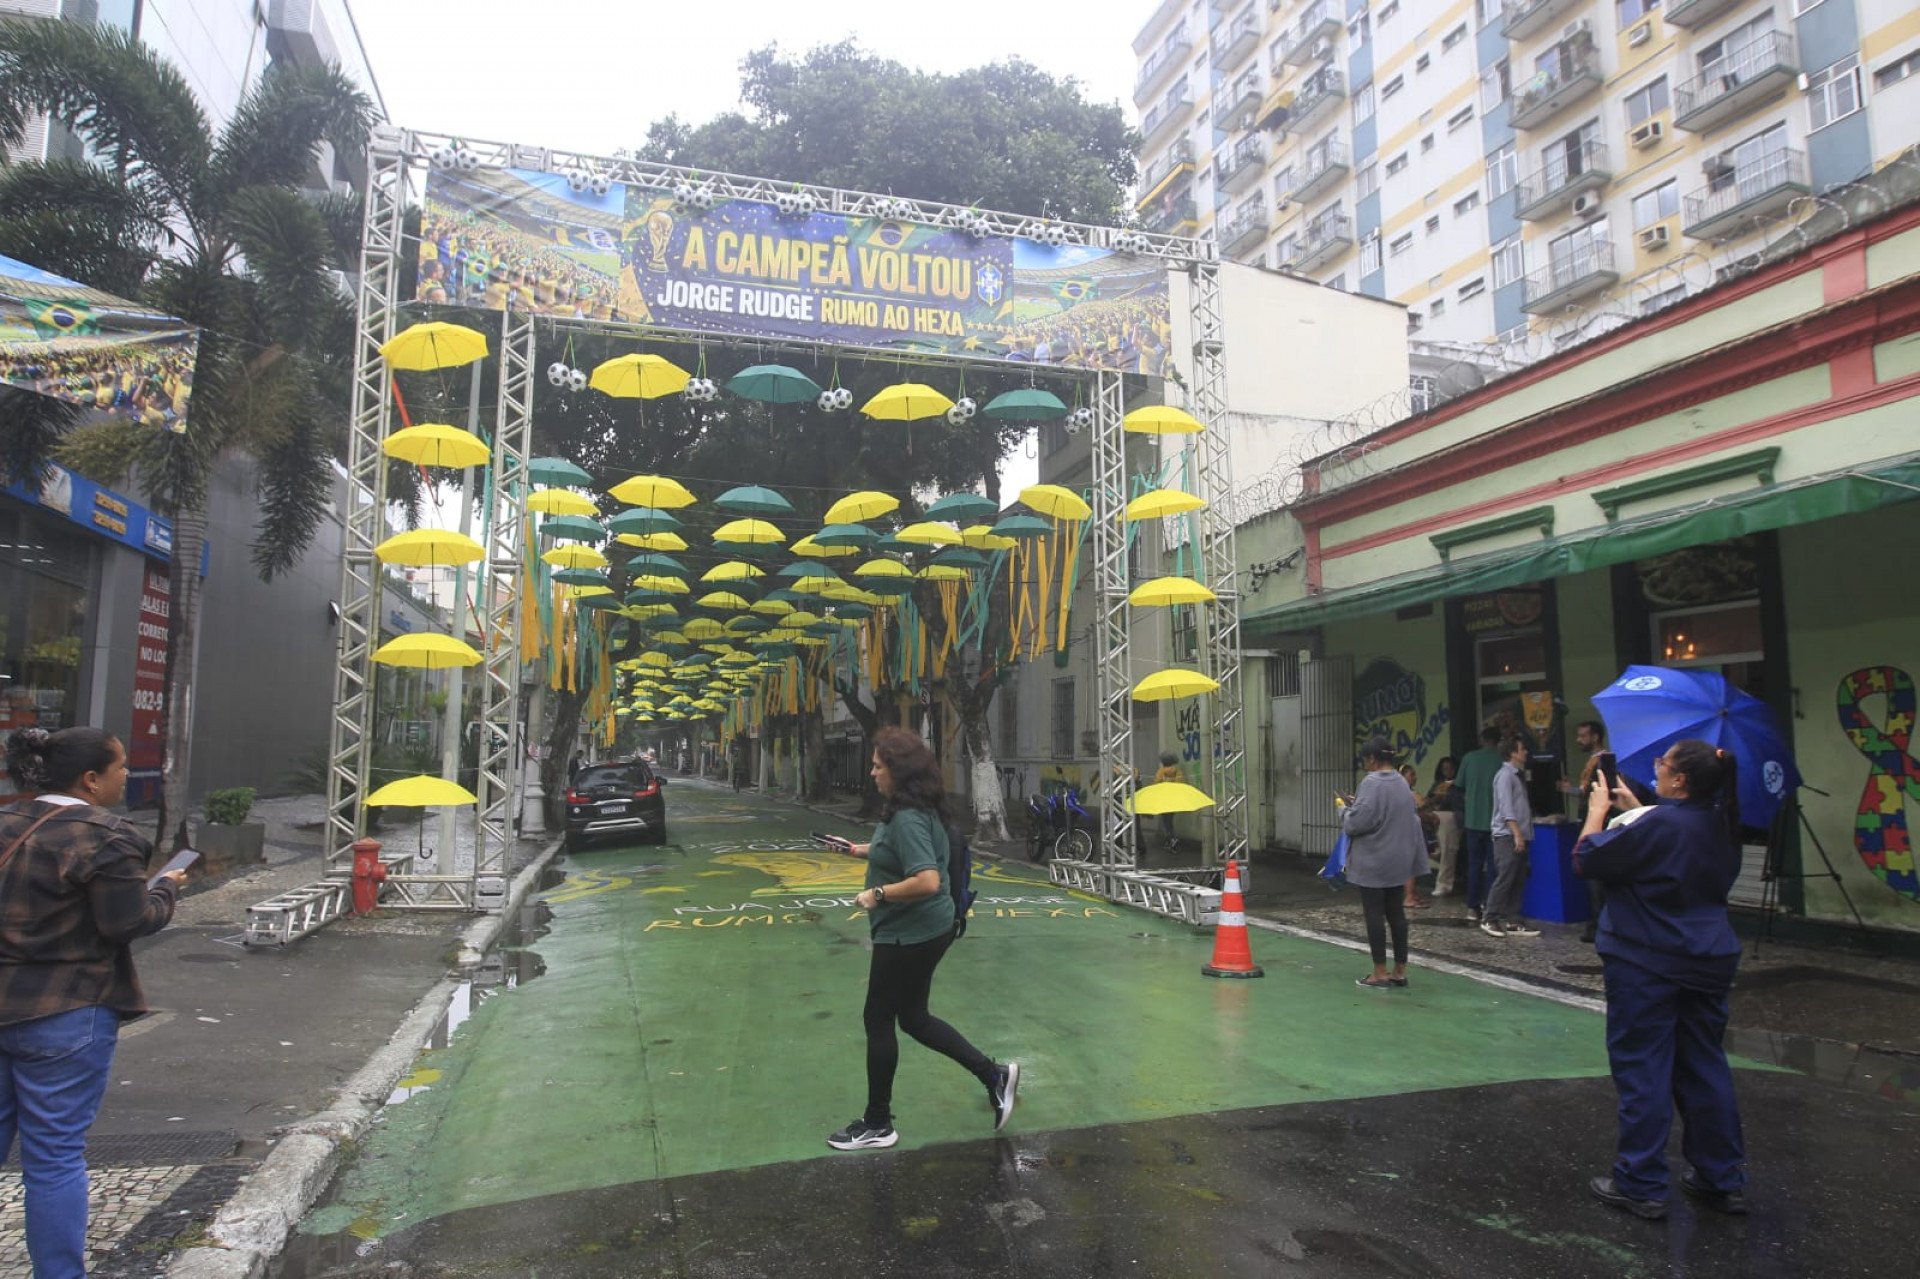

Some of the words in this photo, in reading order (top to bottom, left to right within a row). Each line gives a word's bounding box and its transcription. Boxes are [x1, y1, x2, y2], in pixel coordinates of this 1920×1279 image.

[683, 227, 708, 270] A
[714, 231, 852, 285] CAMPEÃ
[857, 246, 972, 300] VOLTOU
[657, 279, 733, 313] JORGE
[739, 288, 814, 322] RUDGE
[820, 296, 878, 328] RUMO
[882, 304, 909, 331] AO
[913, 306, 965, 337] HEXA
[673, 902, 772, 915] RUA
[966, 906, 1120, 919] HEXA
